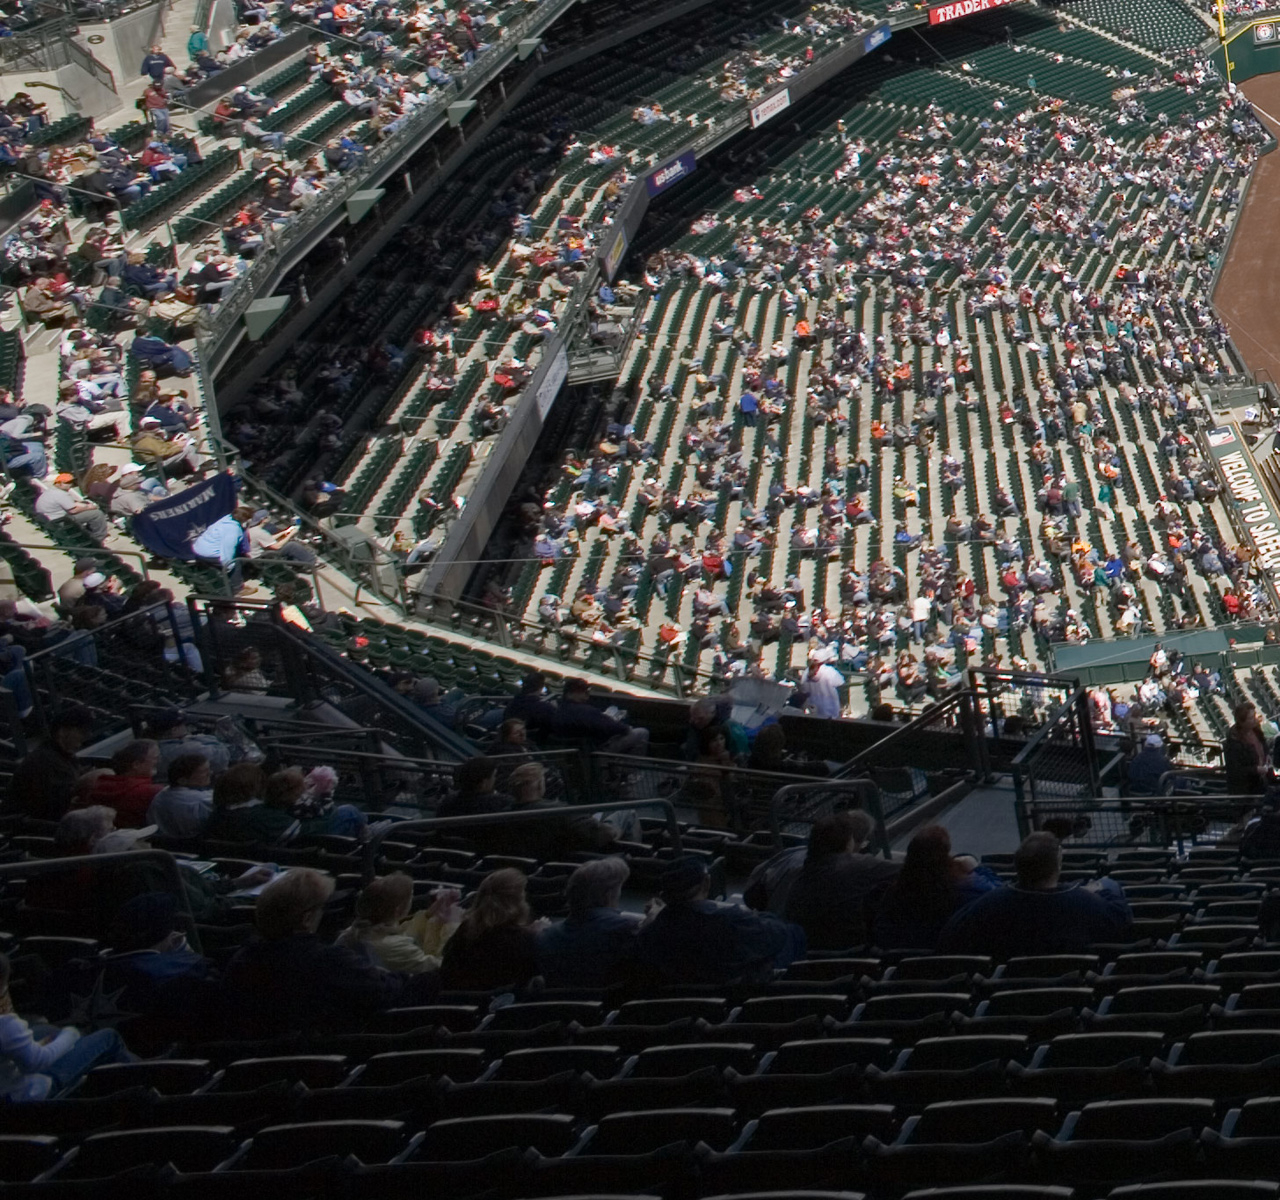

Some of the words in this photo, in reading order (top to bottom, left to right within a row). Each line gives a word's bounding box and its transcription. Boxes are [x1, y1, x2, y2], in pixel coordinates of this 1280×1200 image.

[149, 484, 216, 521] MARINERS
[1218, 450, 1263, 502] WELCOME
[1241, 502, 1270, 523] TO
